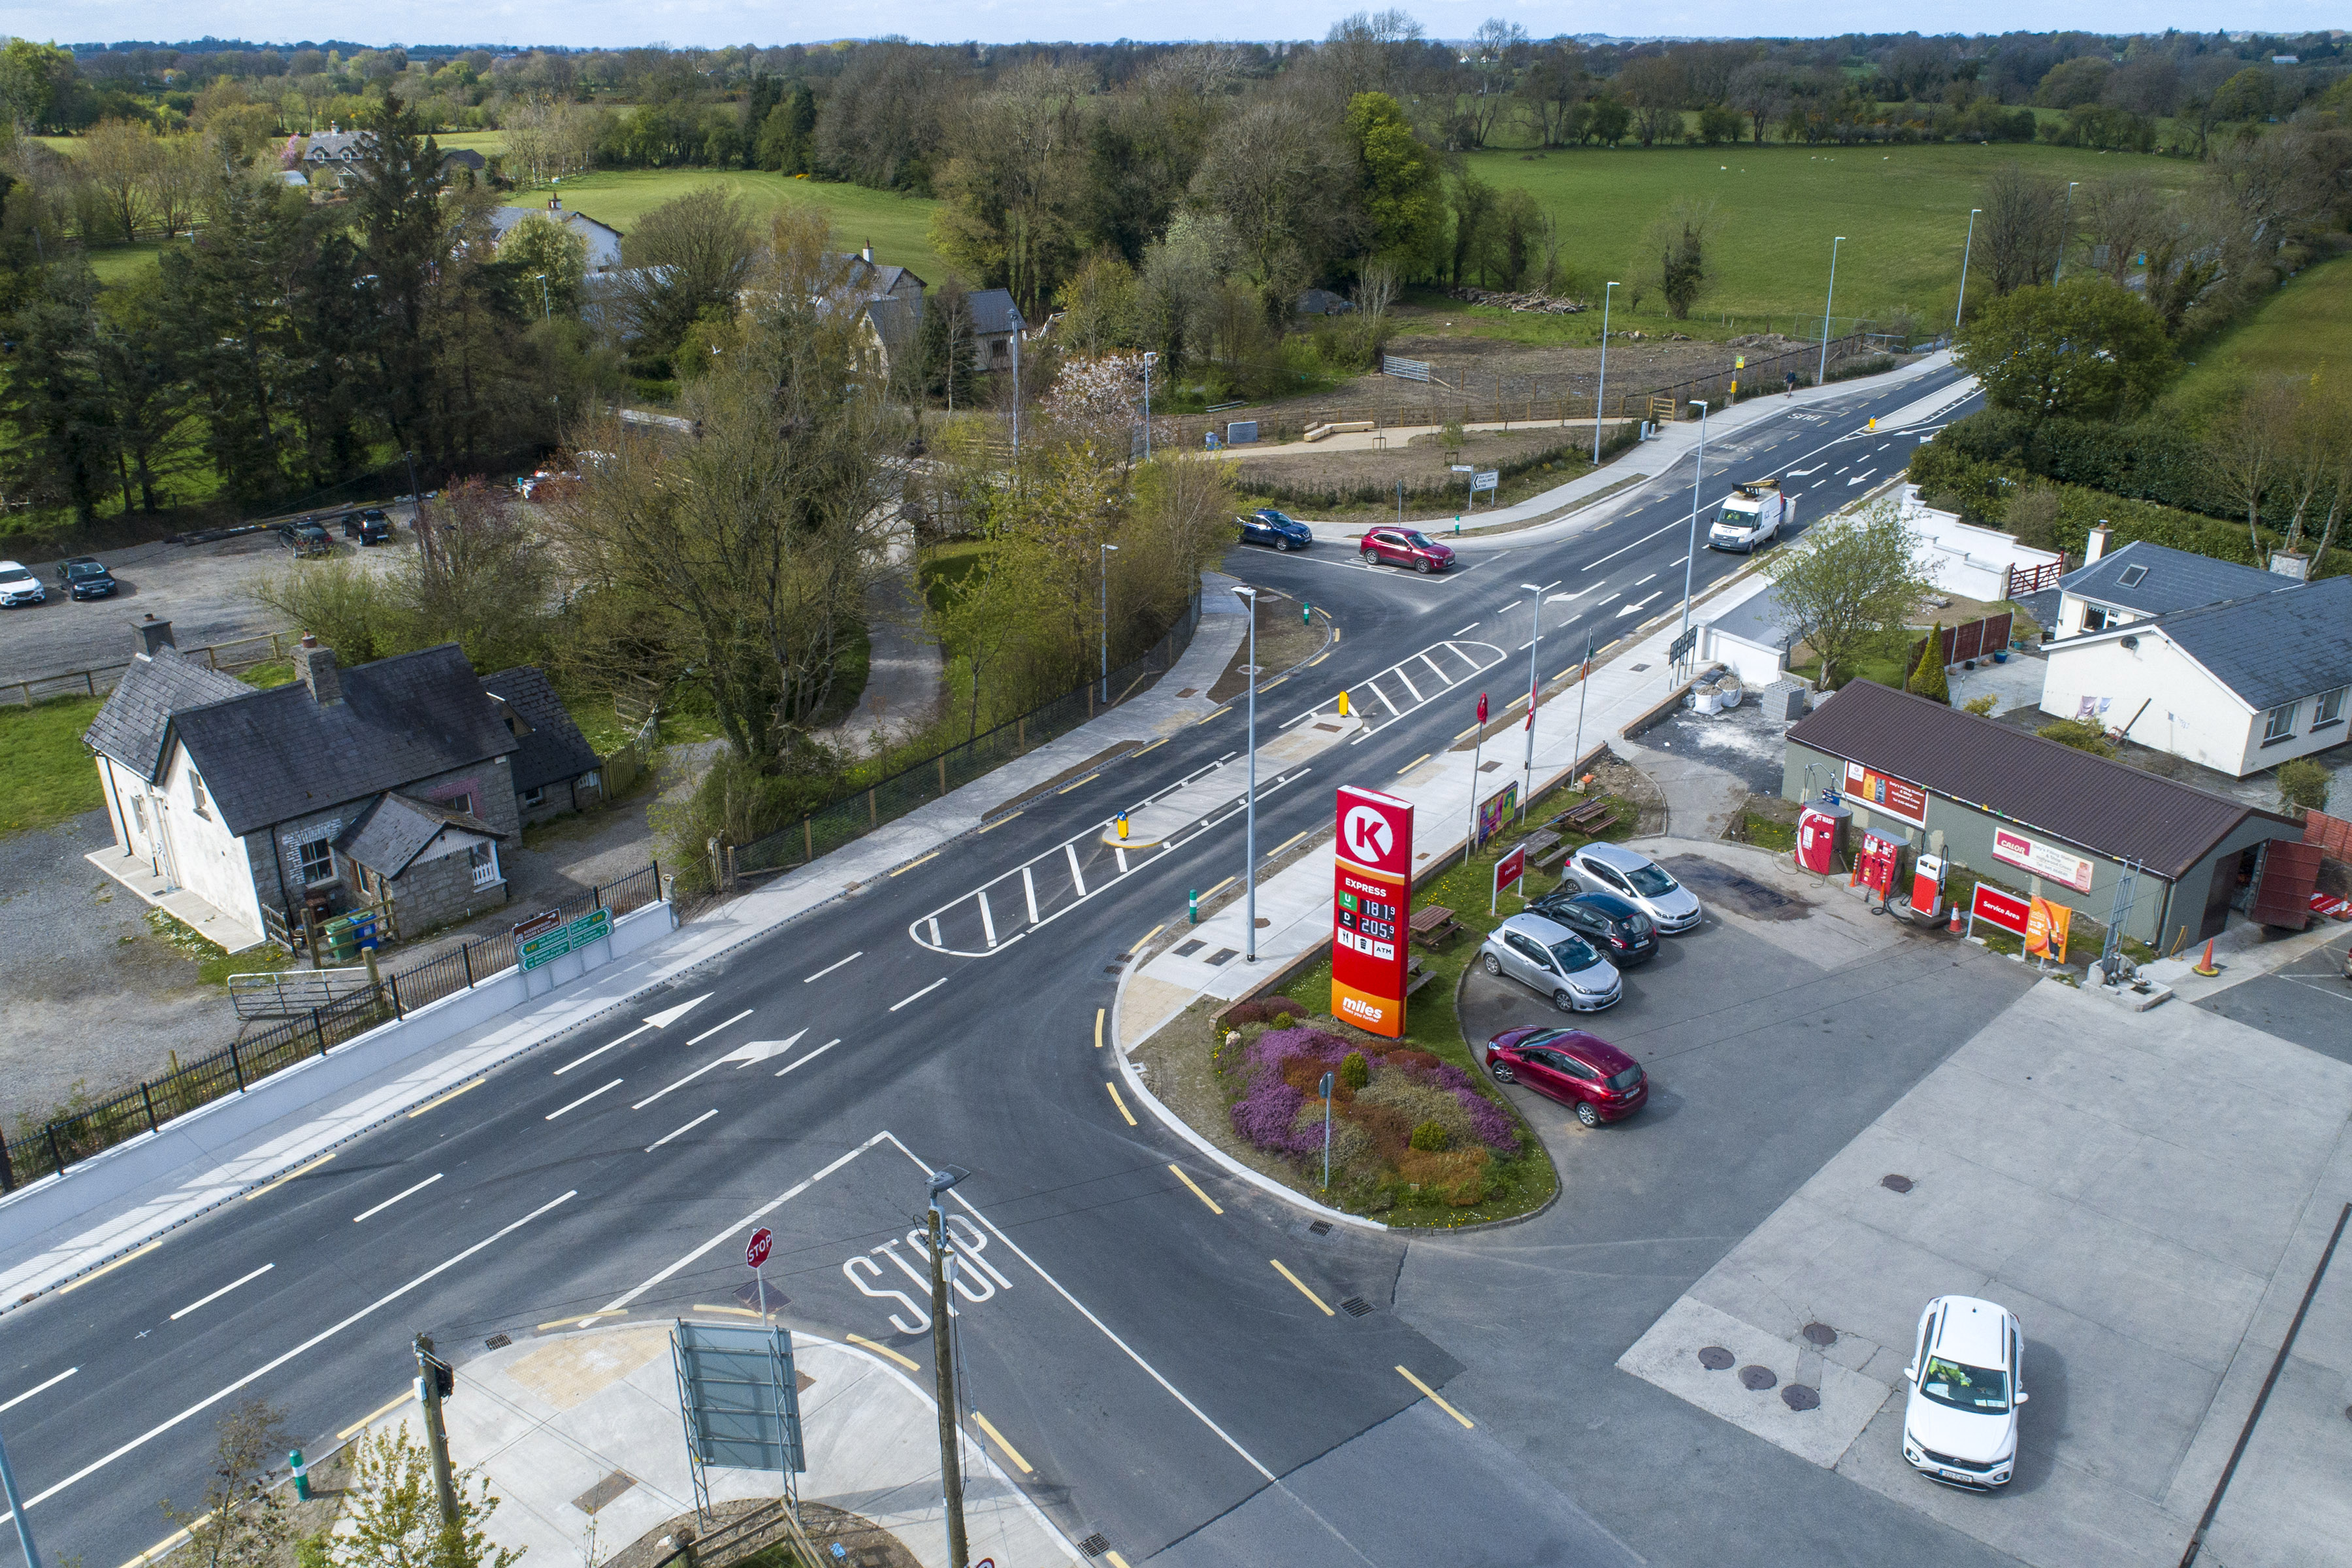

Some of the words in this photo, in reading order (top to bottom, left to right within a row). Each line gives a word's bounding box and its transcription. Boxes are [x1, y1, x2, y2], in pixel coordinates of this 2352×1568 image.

[1787, 413, 1822, 421] BUS
[1821, 816, 1835, 825] WASH
[1356, 816, 1387, 862] K
[2001, 839, 2025, 855] CALOR
[1505, 864, 1516, 875] Parking
[1345, 877, 1386, 897] EXPRESS
[1345, 893, 1351, 902] U
[1344, 912, 1350, 921] D
[1365, 900, 1396, 921] 181.9
[1983, 900, 2005, 914] Service
[2005, 909, 2020, 920] Area
[1362, 918, 1395, 939] 205.9
[1343, 997, 1382, 1019] miles
[1343, 1005, 1354, 1014] Takes
[1363, 1015, 1379, 1023] further
[748, 1234, 771, 1262] STOP
[843, 1214, 1013, 1334] STOP
